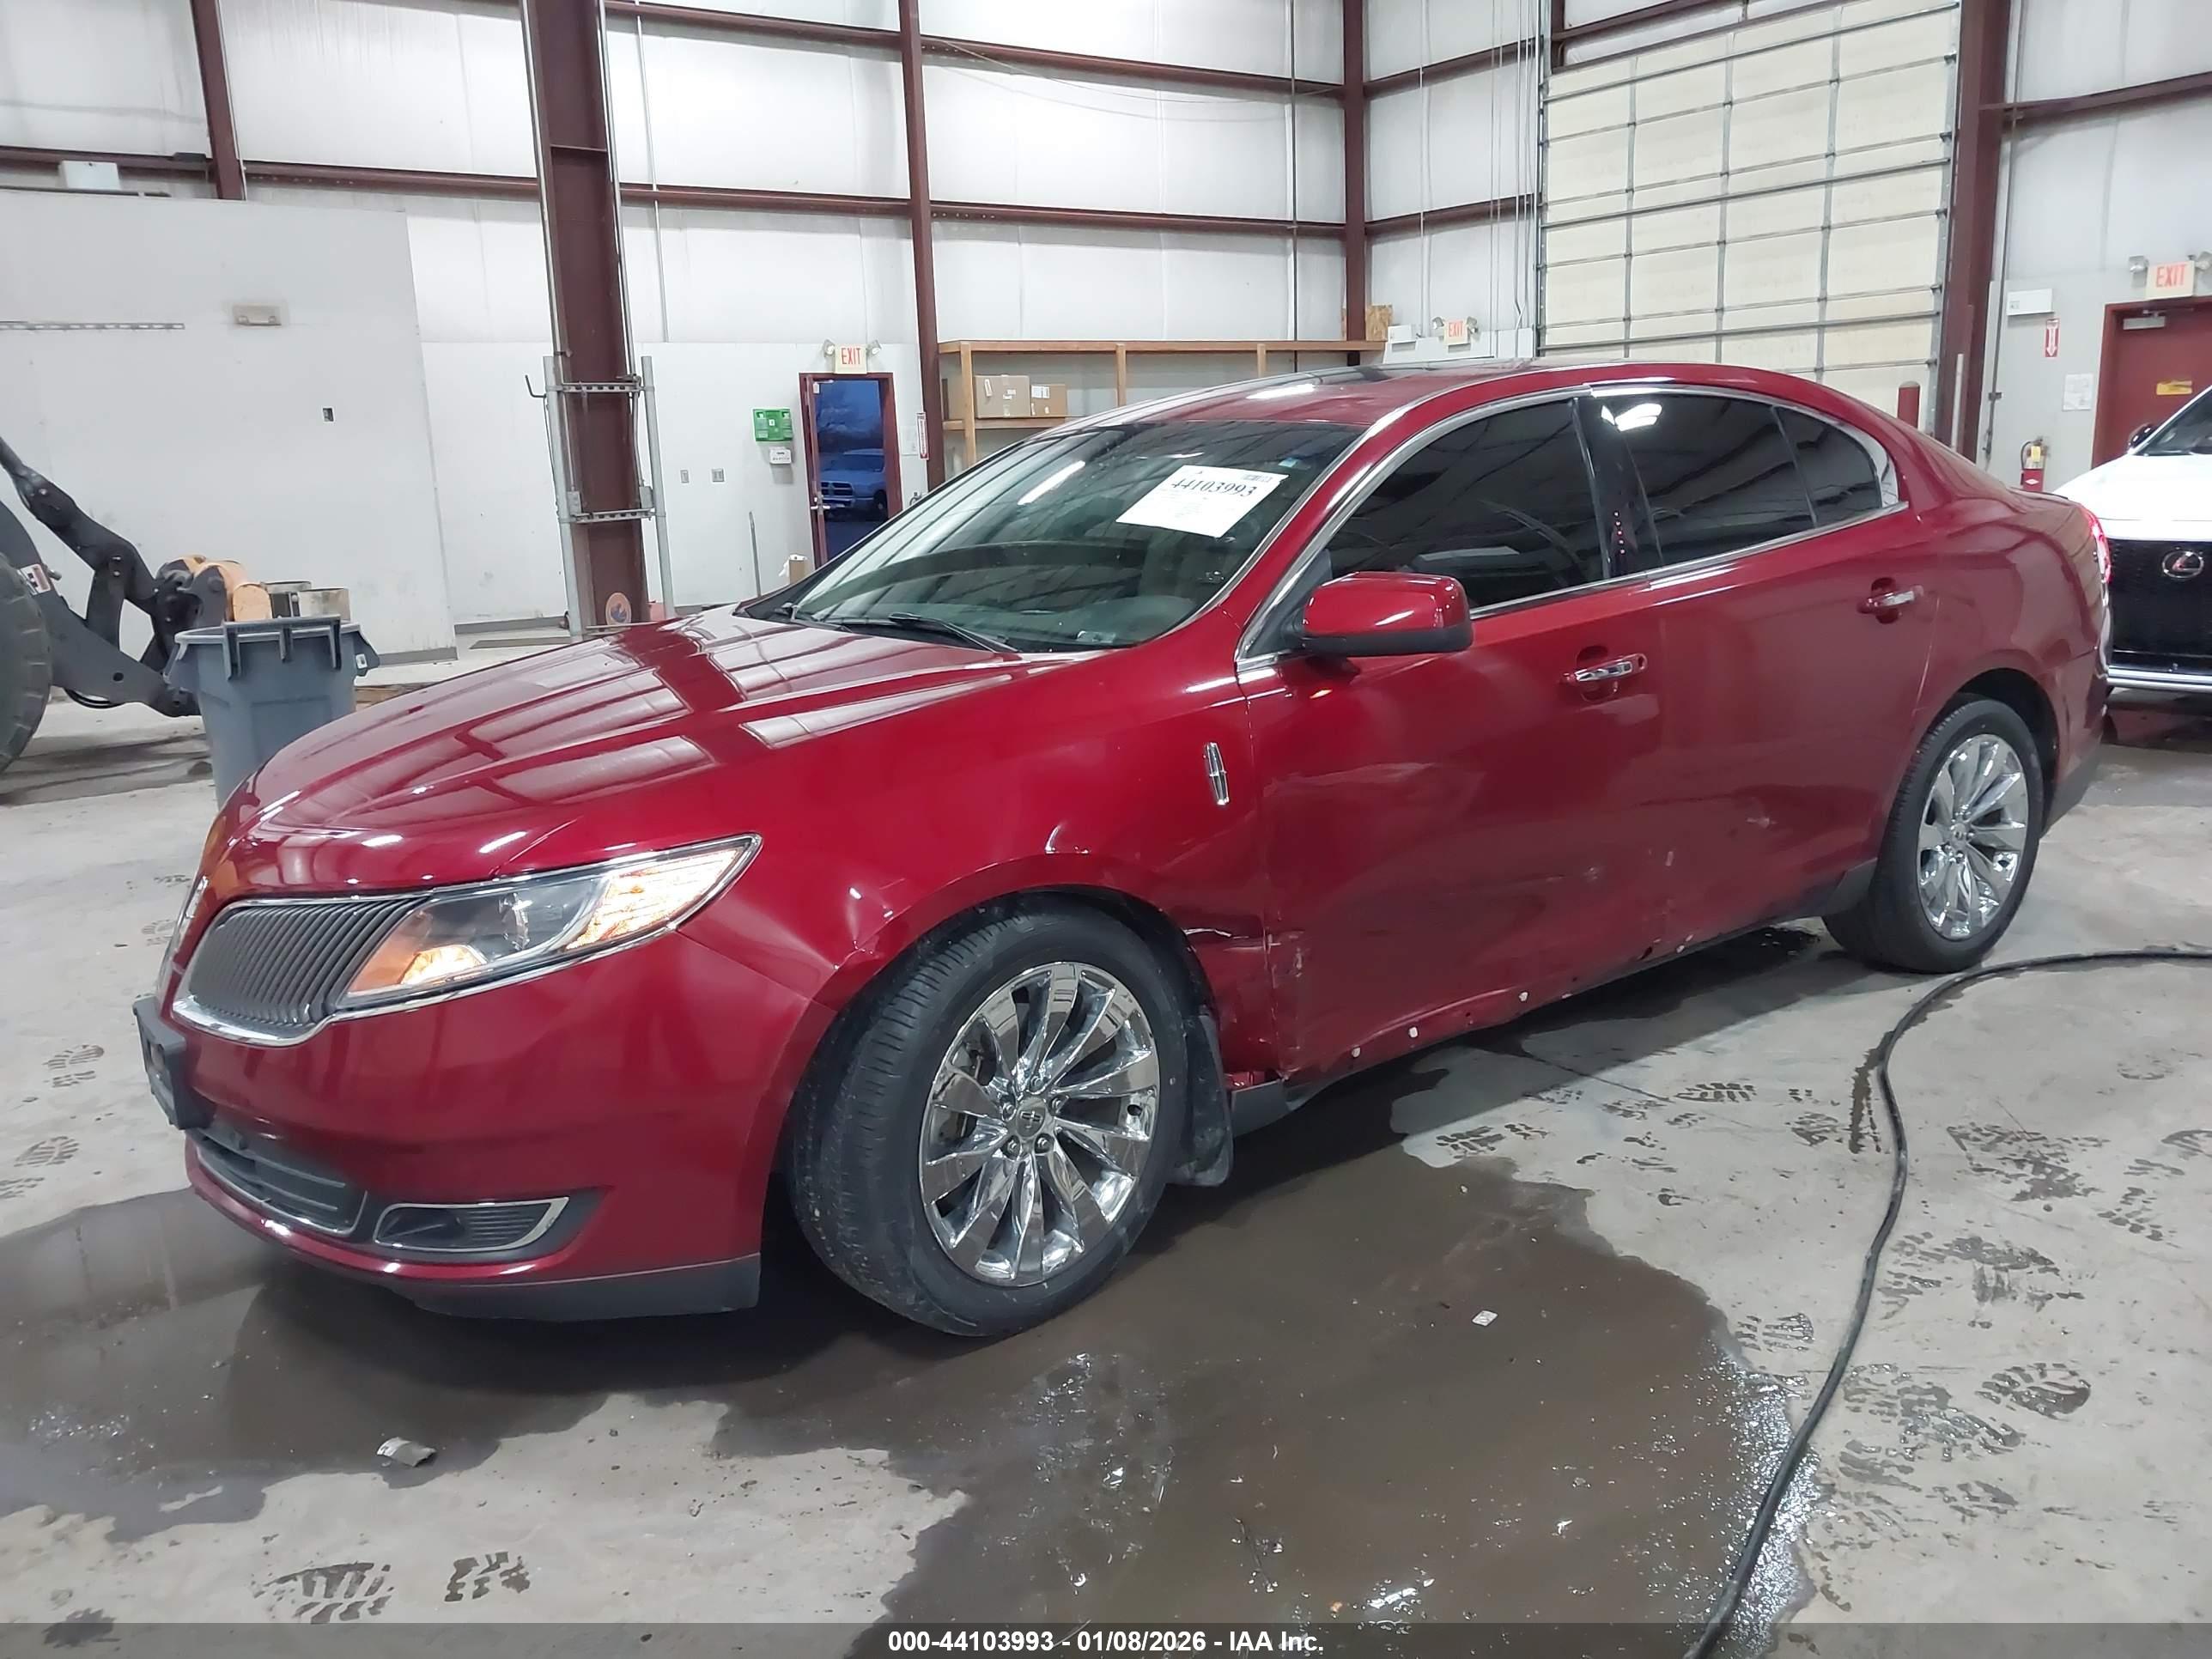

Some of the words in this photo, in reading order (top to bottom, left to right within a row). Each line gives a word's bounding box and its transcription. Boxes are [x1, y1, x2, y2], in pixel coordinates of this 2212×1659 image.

[2155, 264, 2187, 288] EXIT
[1449, 320, 1463, 337] EXIT
[841, 347, 861, 365] EXIT
[1170, 477, 1258, 497] 44103993
